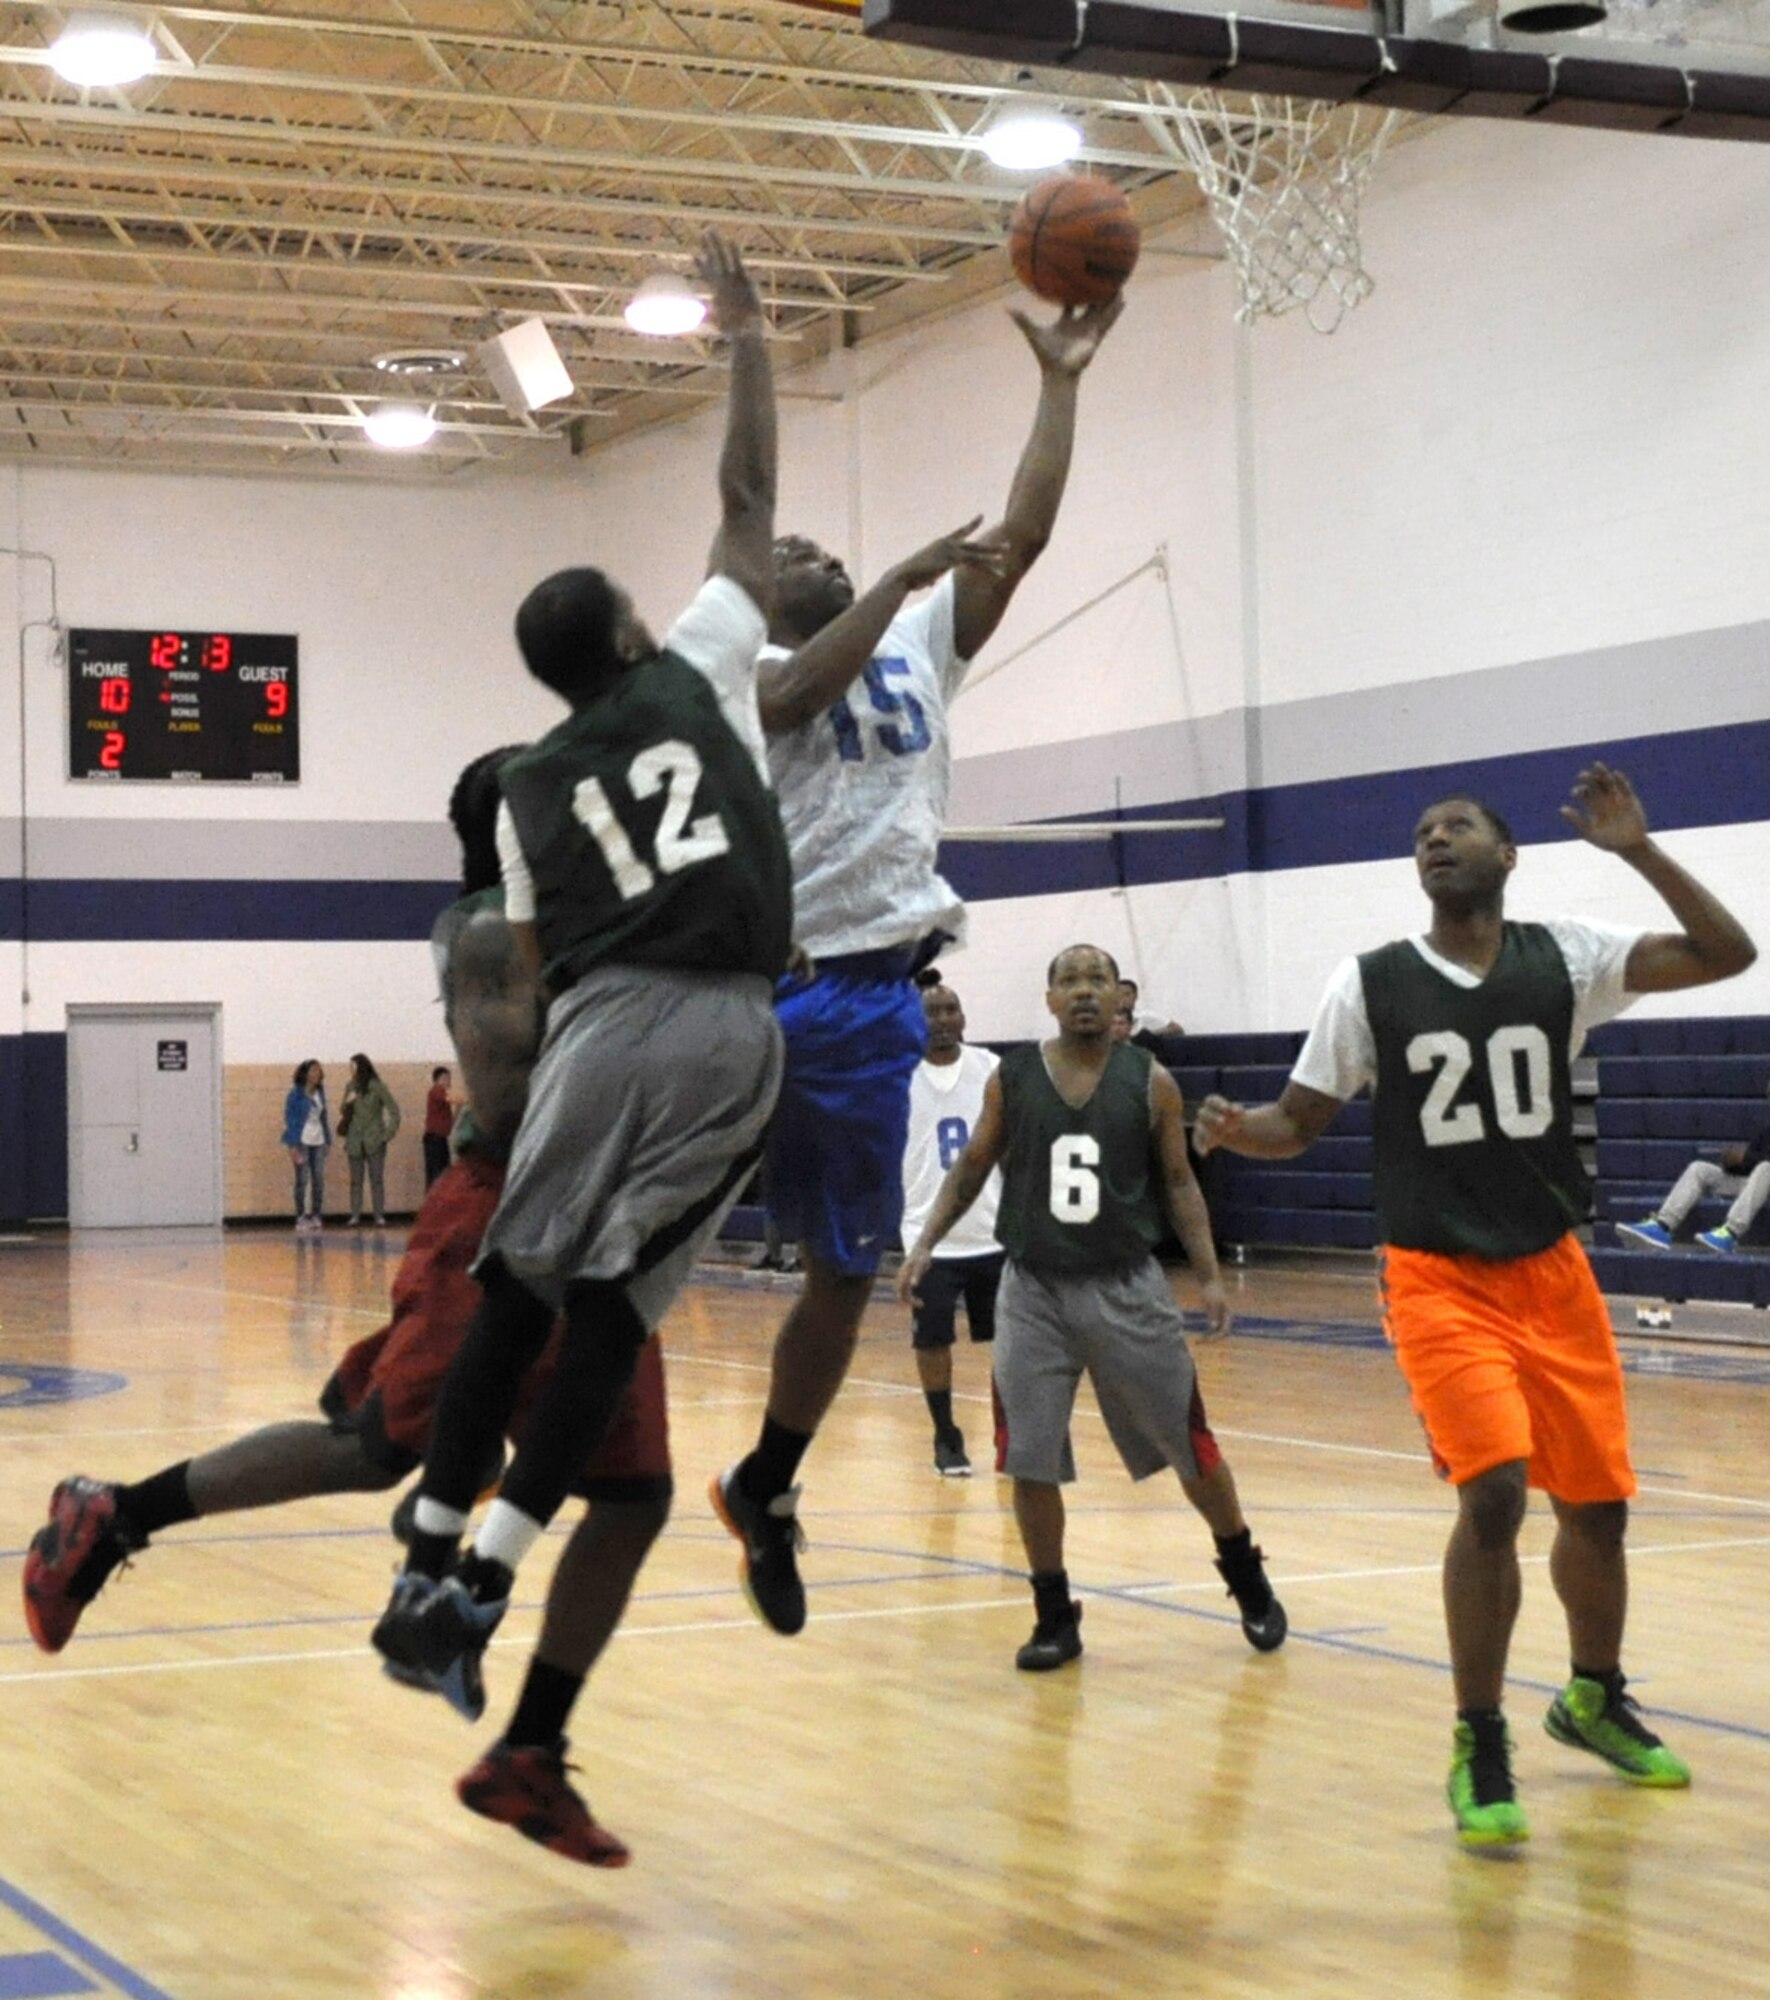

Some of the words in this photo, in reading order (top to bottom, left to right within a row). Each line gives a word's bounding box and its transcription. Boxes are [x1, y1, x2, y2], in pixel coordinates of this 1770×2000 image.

[82, 662, 129, 678] HOME
[168, 671, 200, 681] PERIOD
[238, 666, 288, 681] GUEST
[99, 678, 132, 713] 10
[170, 708, 200, 718] BONUS
[265, 681, 289, 717] 9
[829, 656, 932, 762] 15
[87, 720, 119, 730] FOULS
[252, 723, 283, 733] FOULS
[99, 731, 126, 769] 2
[572, 739, 731, 900] 12
[1405, 1024, 1554, 1146] 20
[1050, 1134, 1100, 1223] 6
